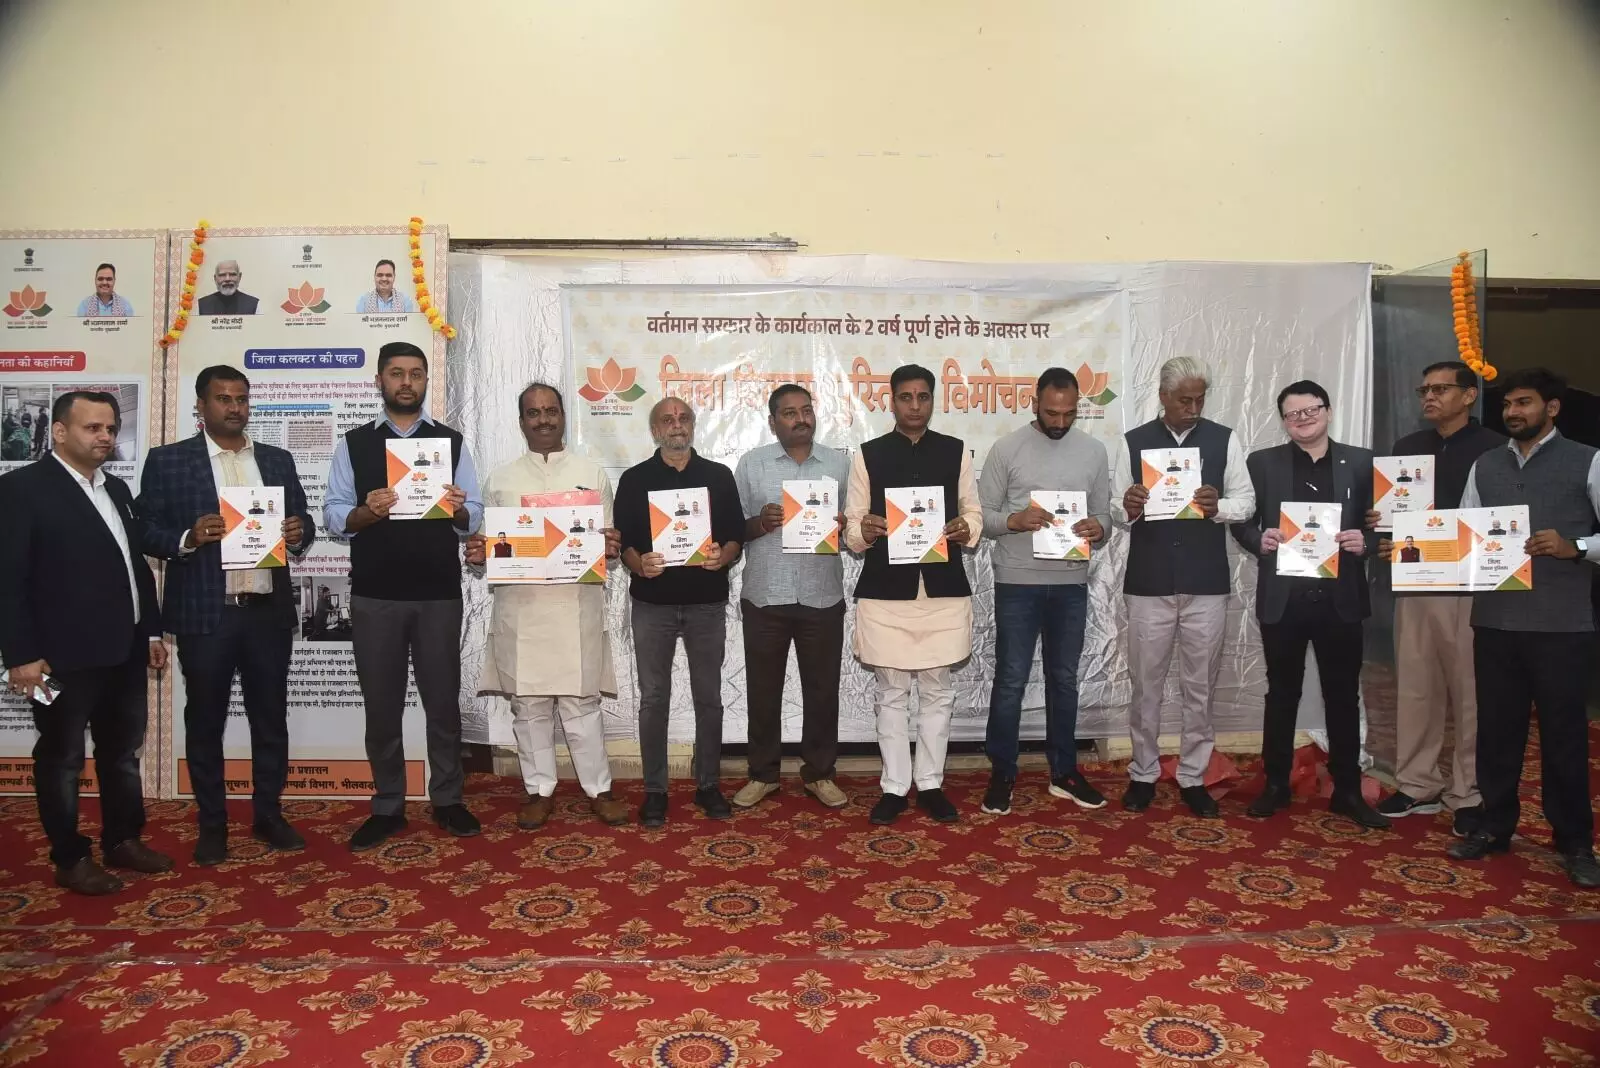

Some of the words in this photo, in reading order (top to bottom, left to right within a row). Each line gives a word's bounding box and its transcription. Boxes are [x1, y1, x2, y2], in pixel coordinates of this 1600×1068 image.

[647, 311, 699, 334] वर्तमान
[701, 317, 752, 334] सरकार
[755, 312, 772, 334] के
[774, 312, 842, 335] कार्यकाल
[845, 313, 861, 336] के
[864, 319, 873, 336] 2
[877, 314, 901, 336] वर्ष
[904, 314, 931, 343] पूर्ण
[934, 315, 961, 339] होने
[964, 315, 980, 337] के
[983, 322, 1027, 339] अवसर
[1030, 323, 1050, 338] पर
[17, 355, 32, 368] की
[252, 352, 276, 365] जिला
[278, 354, 316, 365] कलक्टर
[319, 352, 333, 364] की
[335, 354, 358, 364] पहल
[941, 358, 1038, 414] विमोचन
[297, 766, 328, 776] प्रशासन
[226, 780, 249, 792] सूचना
[310, 778, 338, 791] विभाग,
